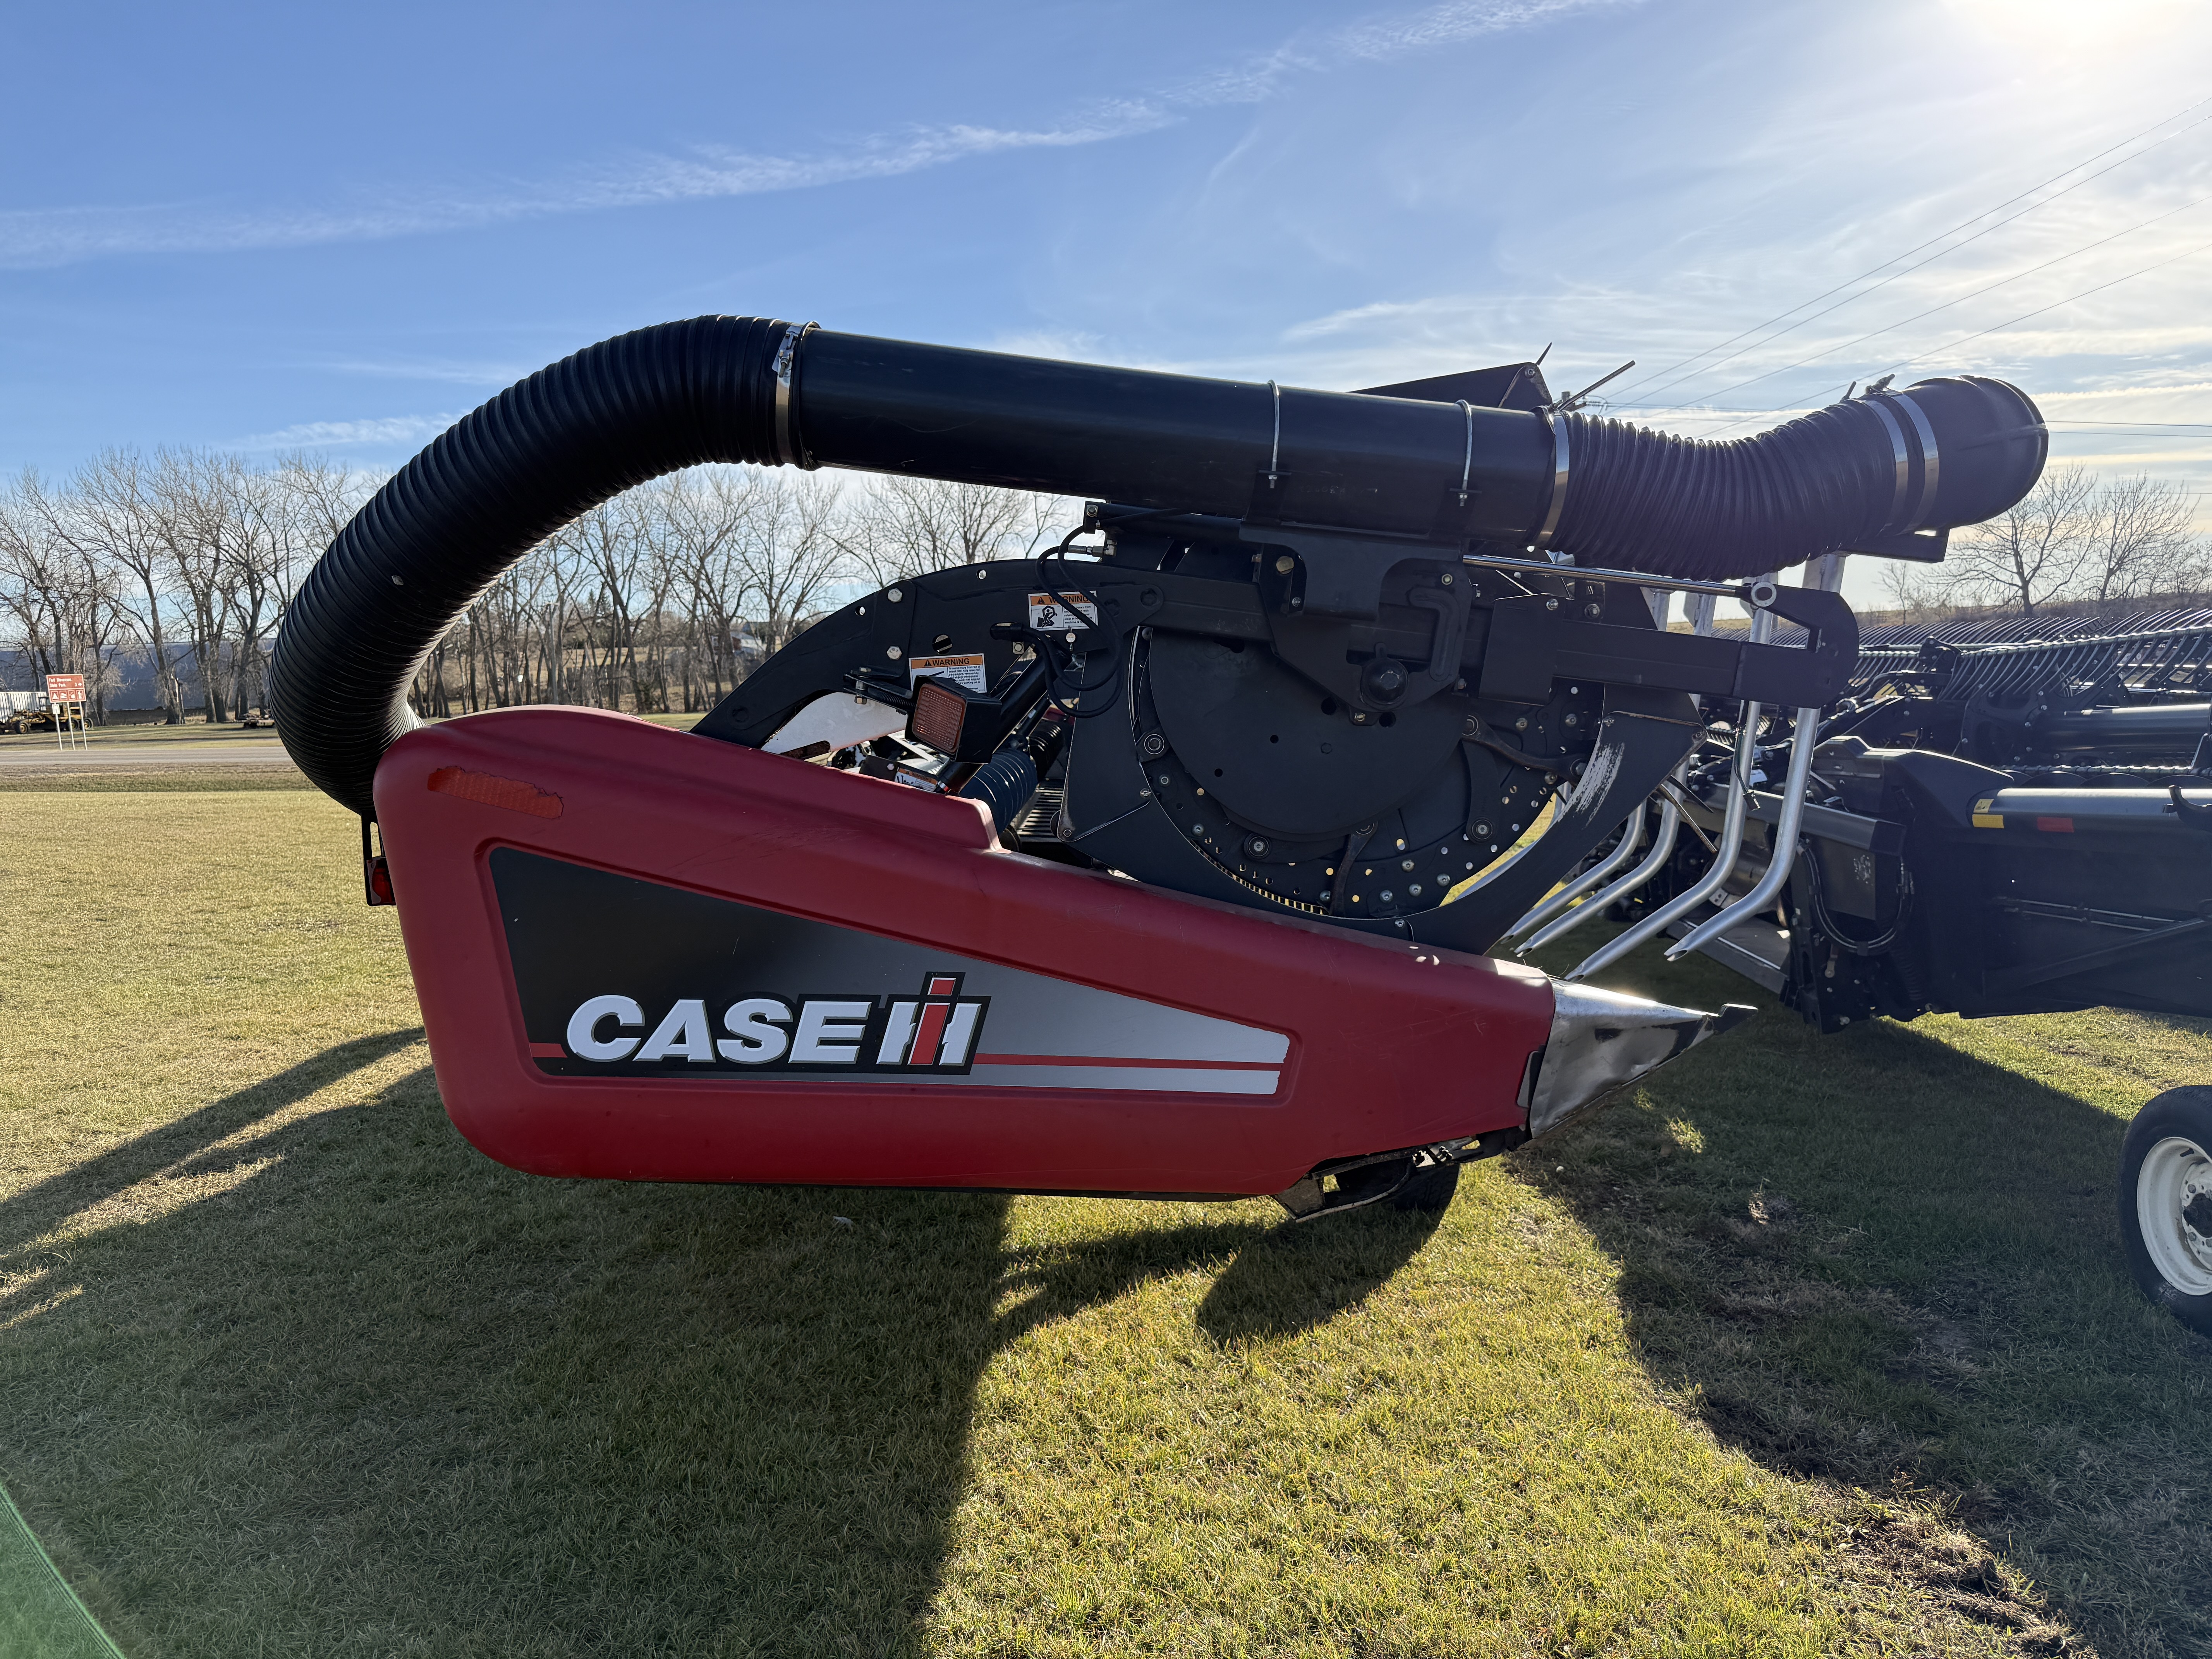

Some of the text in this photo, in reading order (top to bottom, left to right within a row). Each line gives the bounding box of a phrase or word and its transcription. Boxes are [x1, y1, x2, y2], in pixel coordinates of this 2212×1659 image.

[1049, 595, 1089, 603] WNING
[932, 658, 970, 666] WARNING
[567, 994, 871, 1065] CASE
